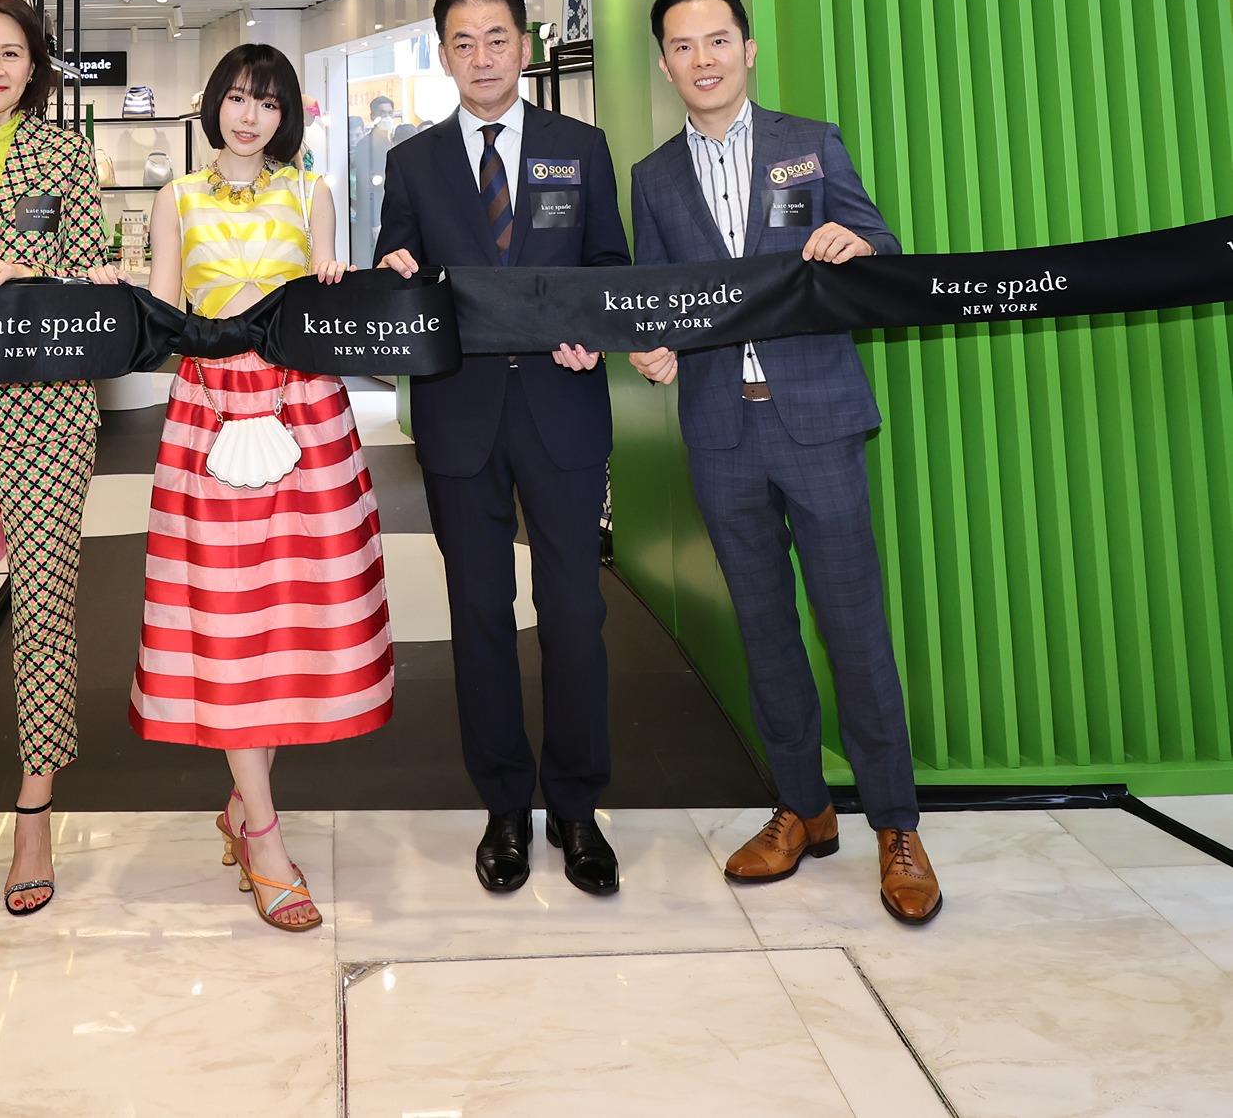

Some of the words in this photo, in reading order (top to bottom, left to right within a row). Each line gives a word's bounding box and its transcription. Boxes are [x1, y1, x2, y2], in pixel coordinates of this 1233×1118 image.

[79, 58, 112, 73] spade
[548, 165, 575, 174] SOGO
[786, 161, 814, 175] SOGO
[930, 277, 988, 295] kate
[996, 270, 1068, 300] spade
[603, 290, 660, 311] kate
[668, 283, 743, 314] spade
[962, 304, 994, 316] NEW
[999, 302, 1038, 313] YORK
[40, 310, 117, 341] spade
[303, 312, 358, 335] kate
[366, 313, 440, 342] spade
[635, 320, 668, 332] NEW
[672, 317, 713, 329] YORK
[4, 346, 38, 358] NEW
[43, 345, 85, 357] YORK
[333, 346, 366, 356] NEW
[372, 345, 412, 355] YORK
